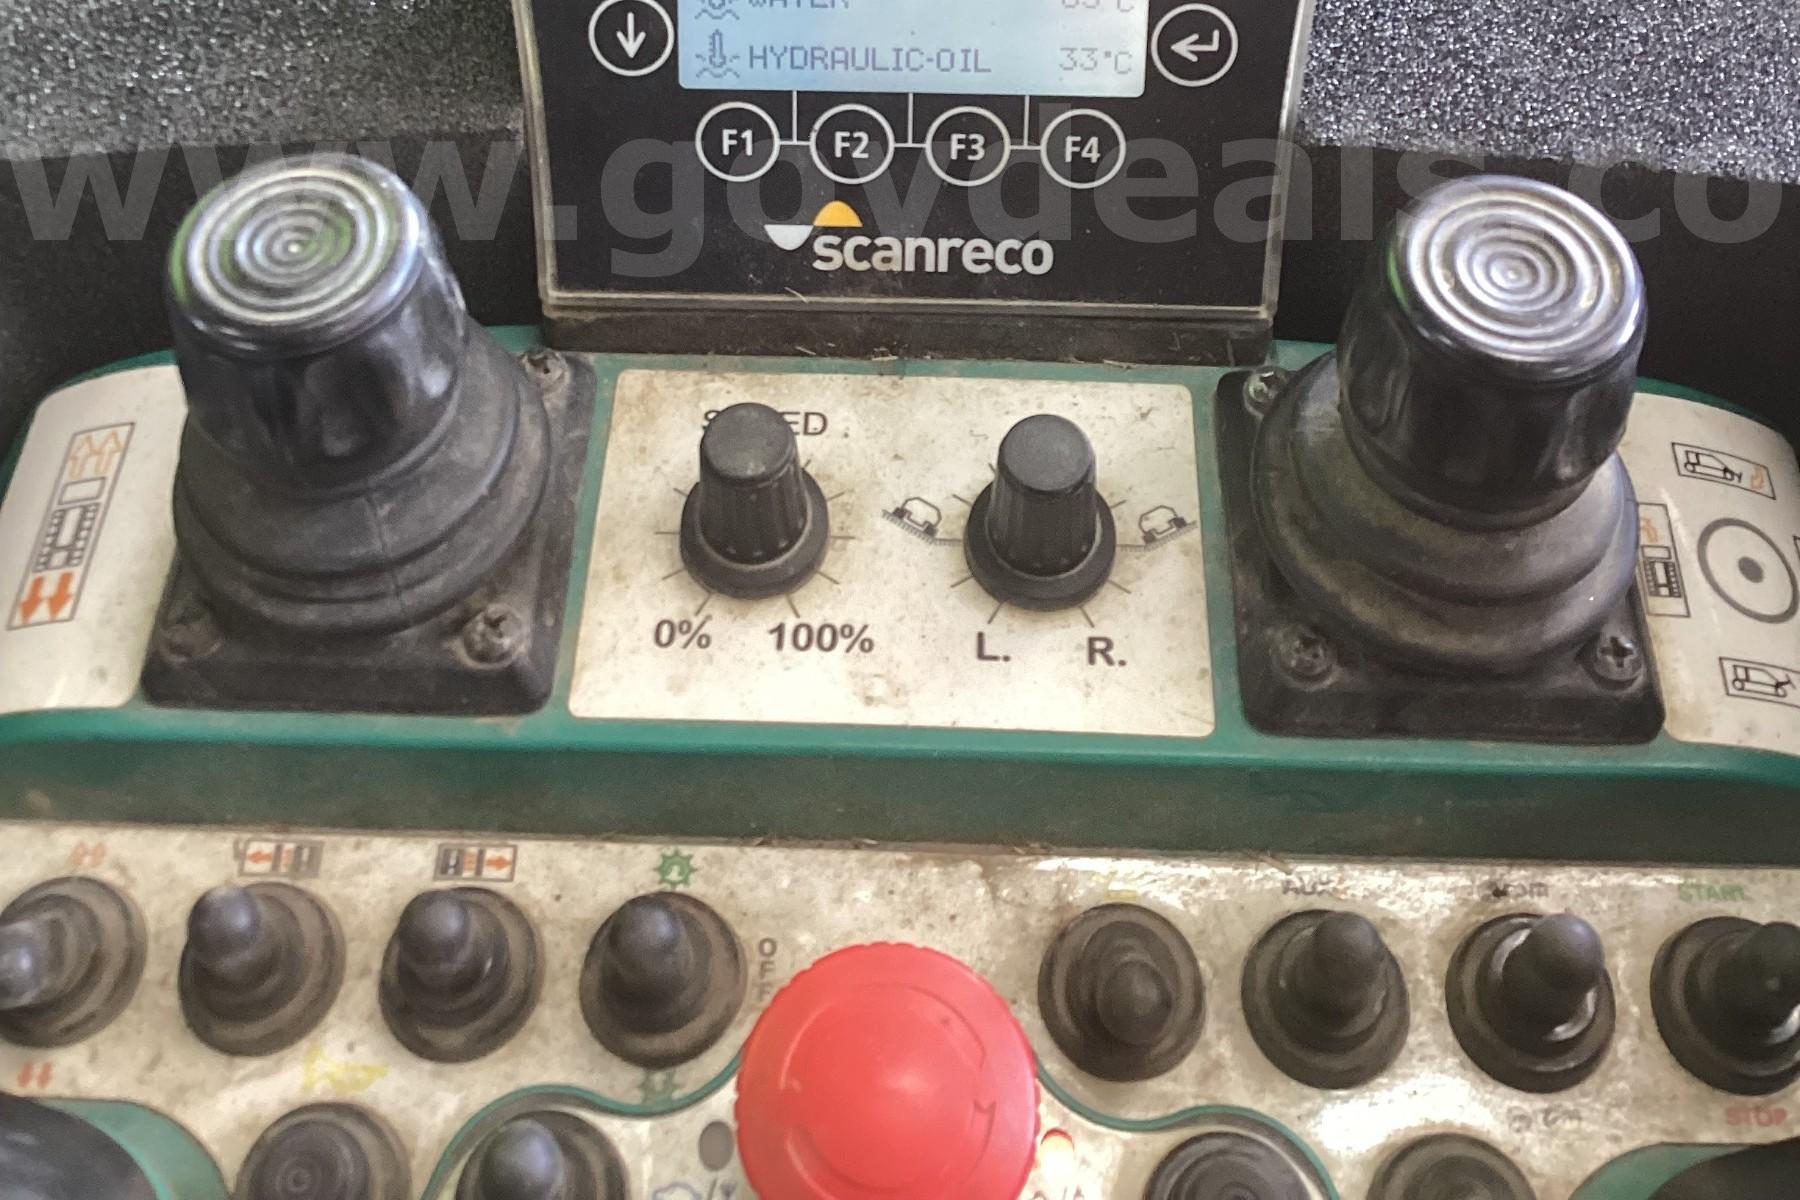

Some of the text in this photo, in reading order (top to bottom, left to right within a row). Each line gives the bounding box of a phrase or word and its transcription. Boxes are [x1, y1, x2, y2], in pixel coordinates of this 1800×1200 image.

[748, 46, 992, 74] HYDRAULIC-OIL
[721, 129, 754, 157] F1
[834, 131, 870, 159] F2
[950, 133, 986, 161] F3
[1064, 135, 1101, 164] F4
[811, 232, 1055, 276] scanreco
[653, 618, 713, 650] 0%
[768, 622, 875, 654] 100%
[976, 630, 1011, 663] L.
[1086, 636, 1127, 668] R.
[1724, 1106, 1788, 1127] STOP
